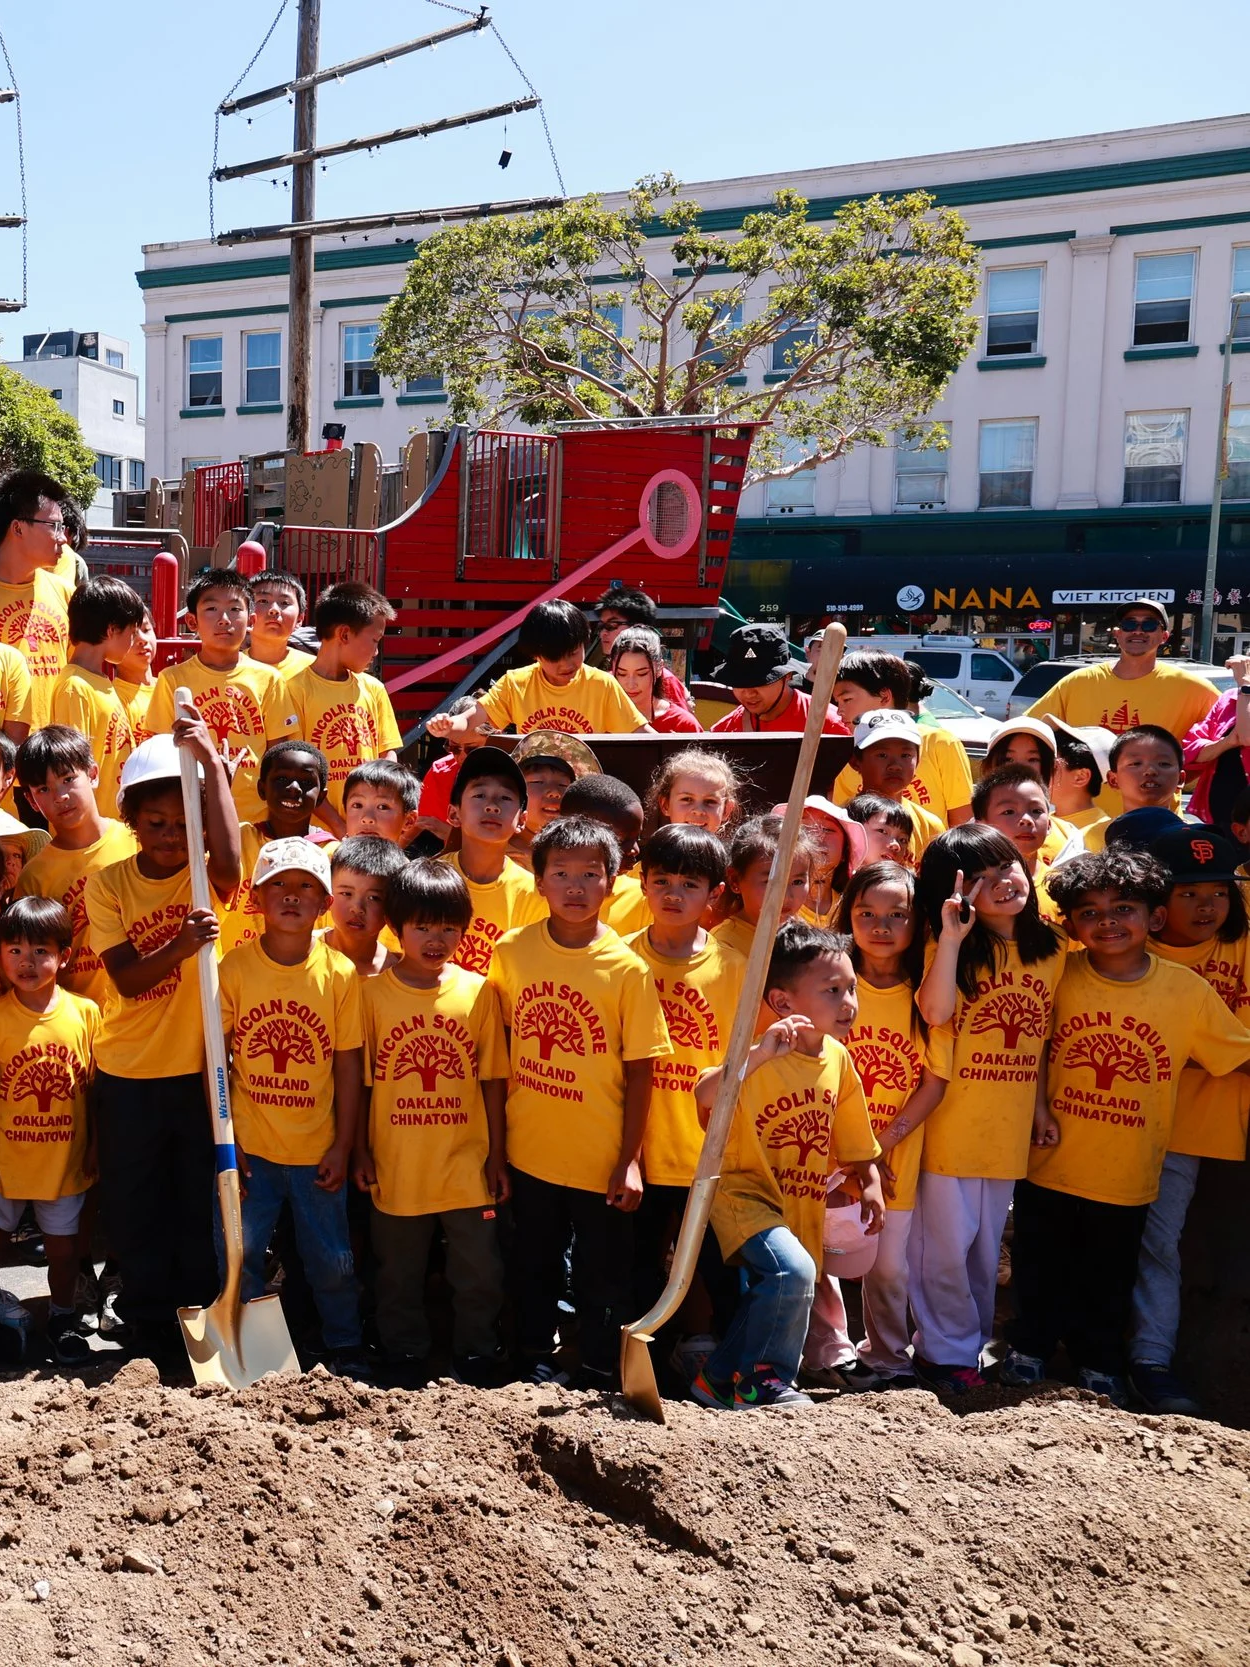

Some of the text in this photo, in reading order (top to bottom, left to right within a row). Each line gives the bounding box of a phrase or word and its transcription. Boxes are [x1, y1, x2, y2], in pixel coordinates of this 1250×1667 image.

[759, 603, 779, 612] 259
[826, 604, 864, 612] 510-519-4999
[934, 586, 1041, 610] NANA
[1058, 591, 1169, 602] VIET KITCHEN
[1028, 621, 1052, 631] OPEN
[224, 685, 265, 736] SQUARE
[558, 707, 594, 735] SQUAR
[330, 758, 366, 769] OAKLA
[513, 981, 607, 1054] LINCOLN SQUARE
[672, 981, 720, 1052] SQUARE
[235, 999, 332, 1061] LINCOLN SQUARE
[375, 1014, 478, 1081] LINCOLN SQUARE
[1049, 1011, 1172, 1082] LINCOLN SQUARE
[520, 1056, 576, 1084] OAKLAND
[972, 1052, 1037, 1067] OAKLAND
[249, 1074, 310, 1092] OAKLAND
[396, 1097, 462, 1110] OAKLAND
[1063, 1086, 1141, 1112] OAKLAND
[13, 1115, 73, 1126] OAKLAND
[390, 1112, 468, 1126] CHINATOWN
[1052, 1099, 1146, 1128] CHINATOWN
